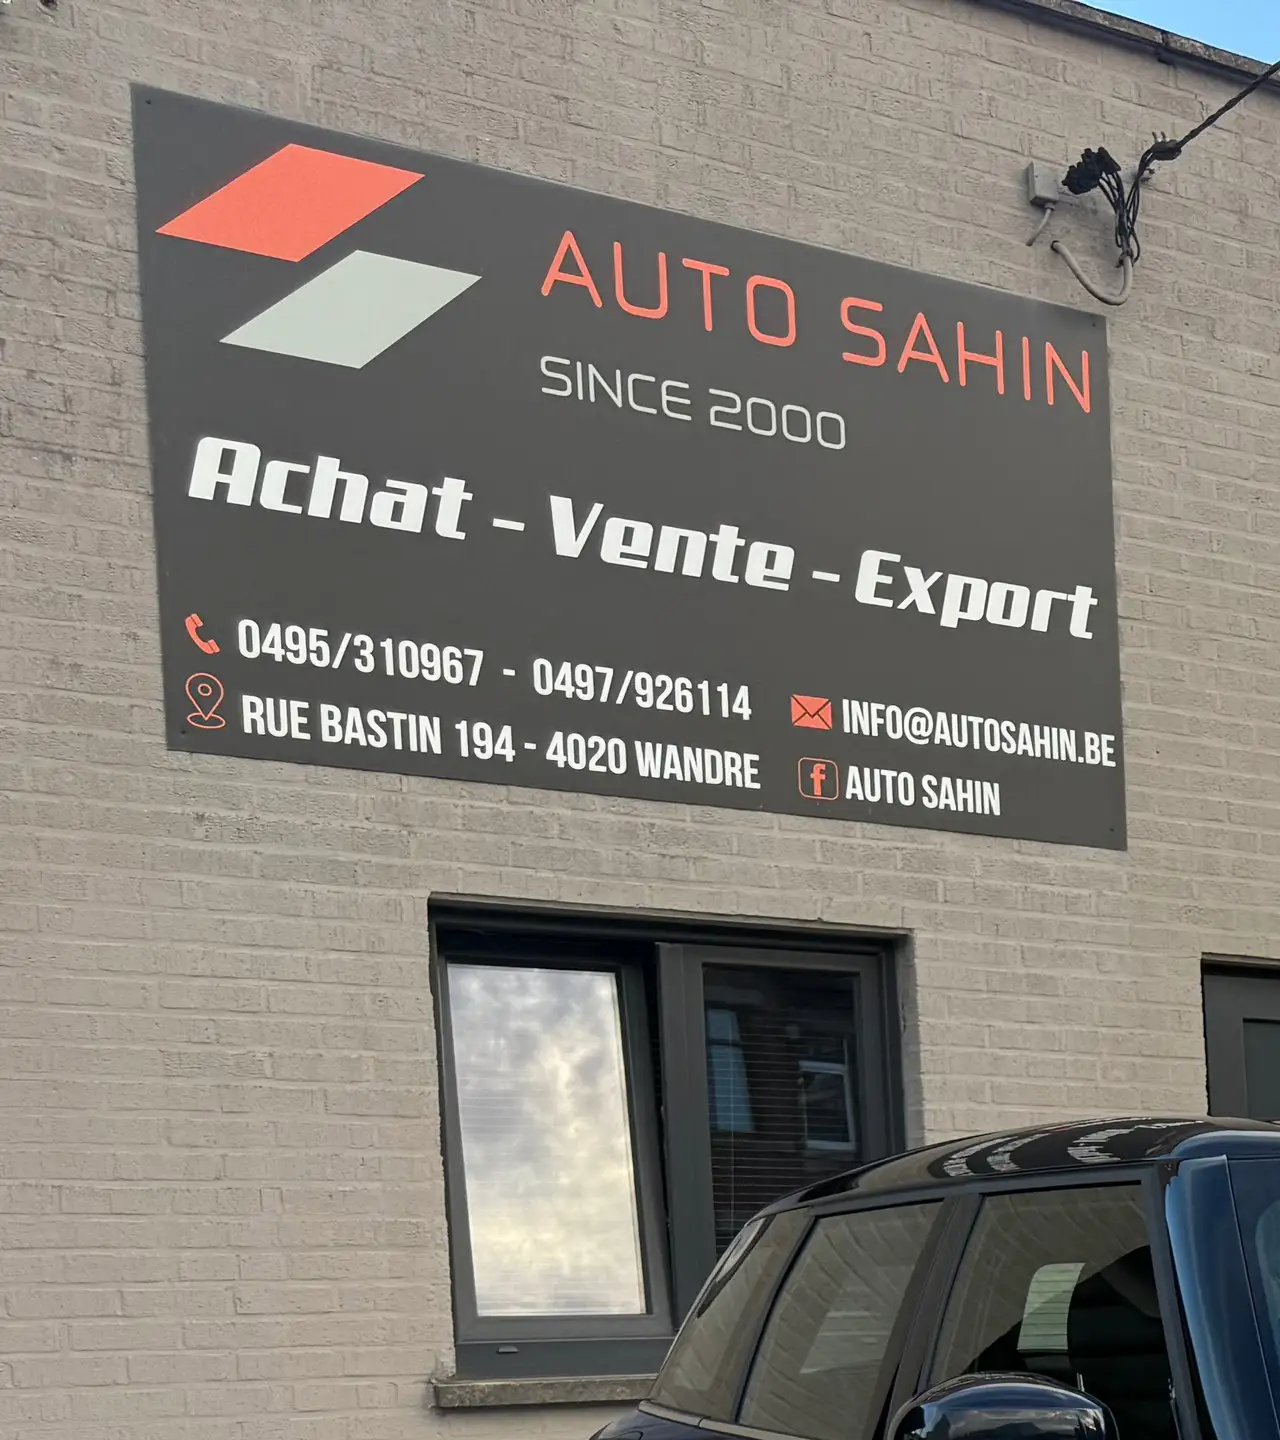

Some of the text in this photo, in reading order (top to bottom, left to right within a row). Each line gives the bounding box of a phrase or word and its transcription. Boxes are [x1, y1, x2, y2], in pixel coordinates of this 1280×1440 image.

[541, 231, 1090, 413] AUTO SAHIN
[541, 356, 845, 449] SINCE 2000
[189, 437, 1098, 639] Achat - Vente - Export
[238, 619, 483, 686] 0495/310967
[533, 658, 751, 720] 0497/926114
[242, 695, 310, 740] RUE
[320, 704, 441, 754] BASTIN
[455, 720, 515, 762] 194
[546, 731, 626, 774] 4020
[635, 741, 760, 789] WANDRE
[843, 699, 1116, 767] INFO@AUTOSAHIN.BE
[846, 766, 1000, 815] AUTO SAHIN
